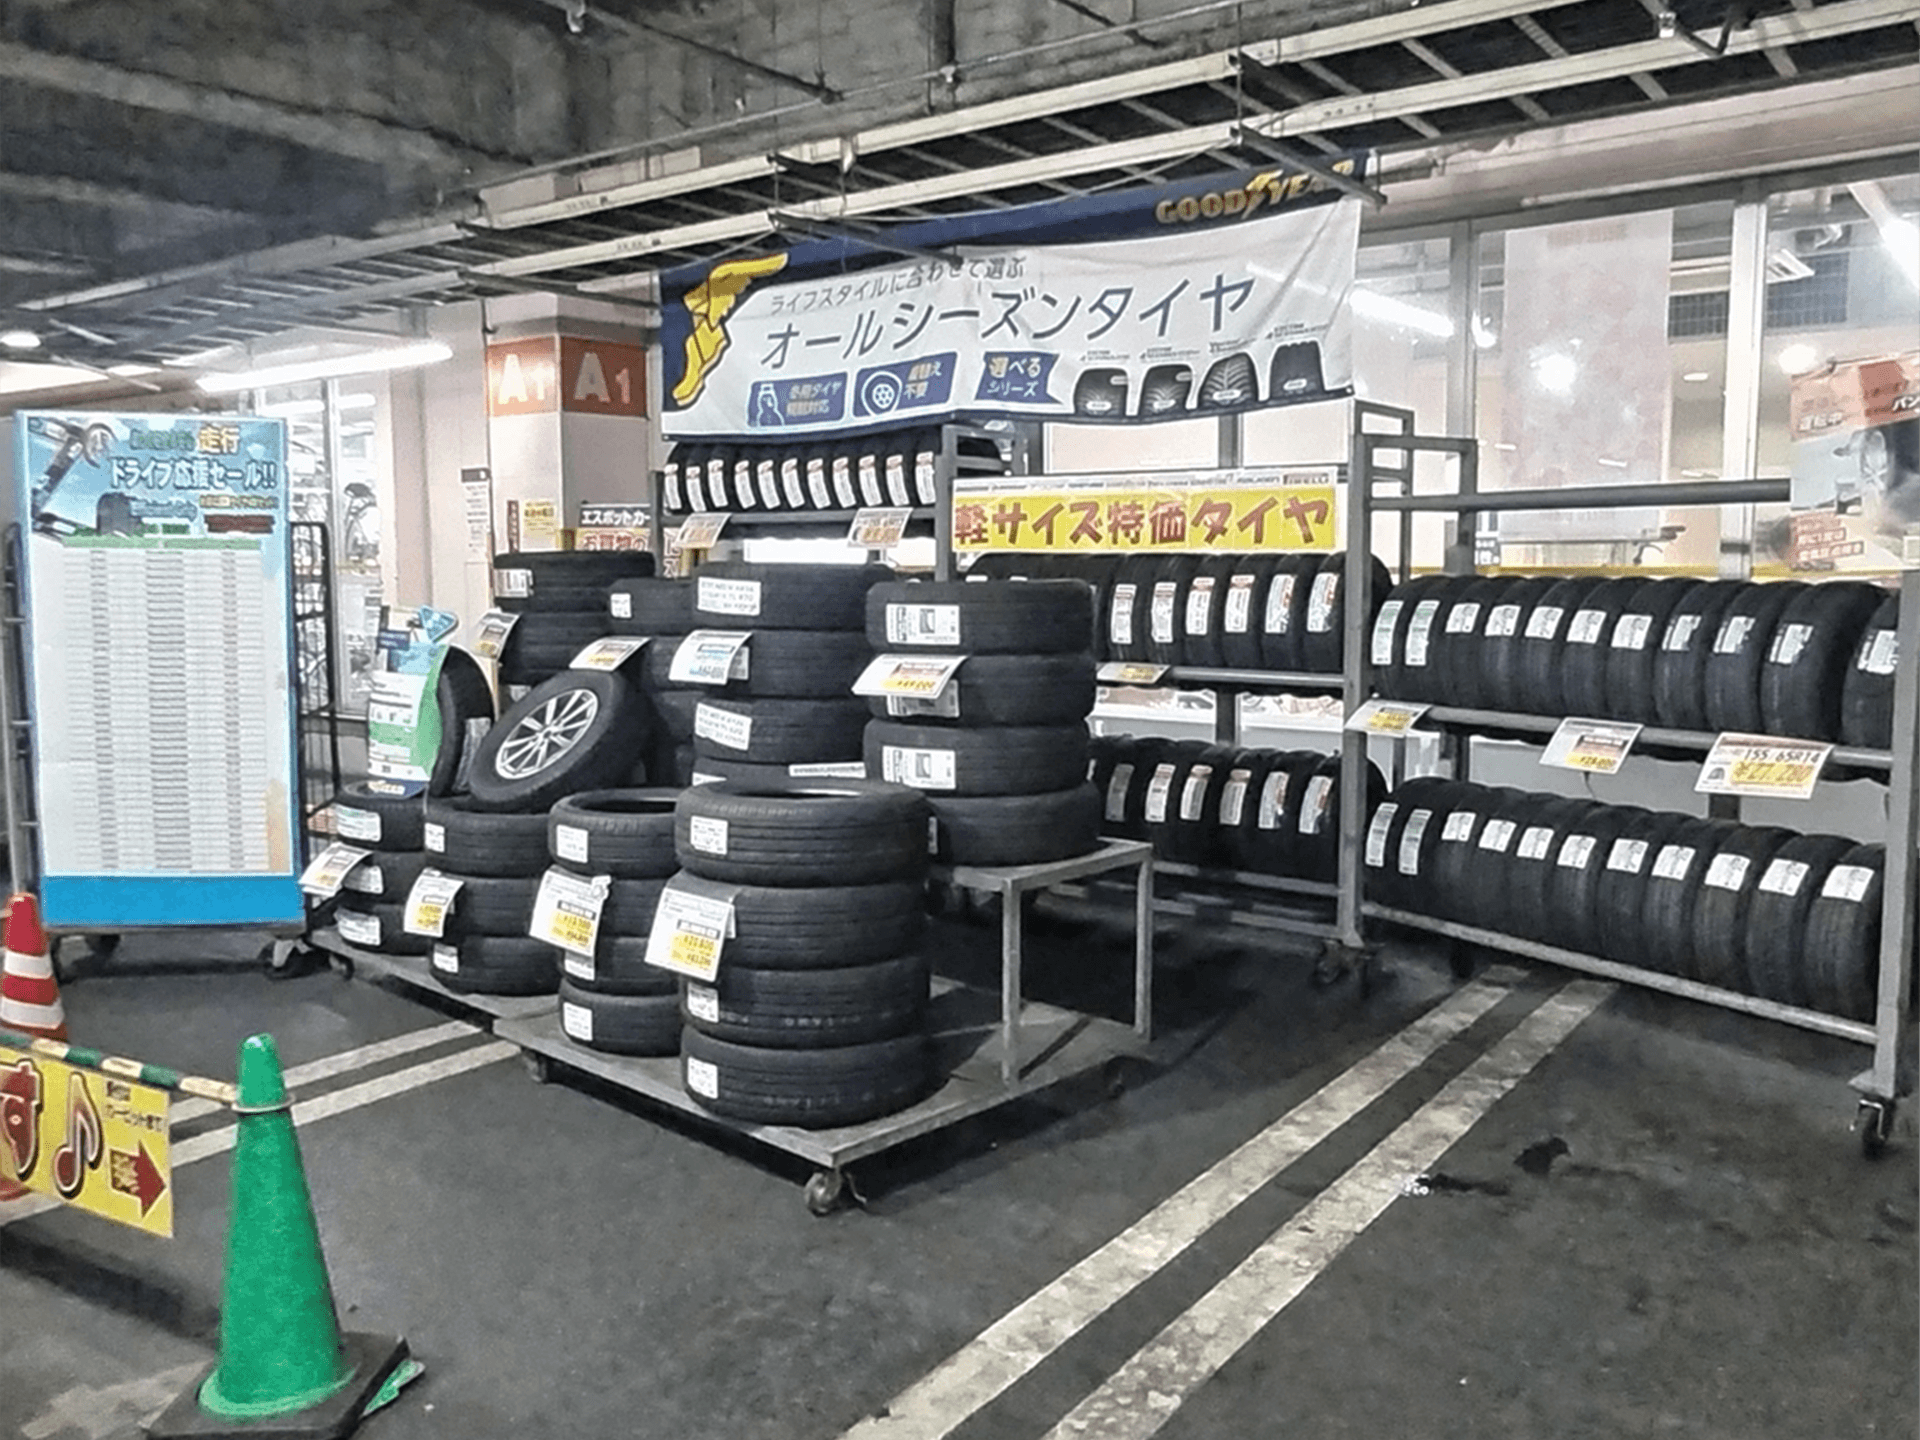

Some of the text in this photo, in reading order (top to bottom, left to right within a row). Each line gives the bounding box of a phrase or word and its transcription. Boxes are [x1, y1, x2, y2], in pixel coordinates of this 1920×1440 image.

[1156, 169, 1330, 224] GOODYEA
[760, 274, 1255, 370] オールシーズンタイヤ
[574, 352, 631, 404] A1
[955, 496, 1329, 545] 軽サイズ特価タイヤ
